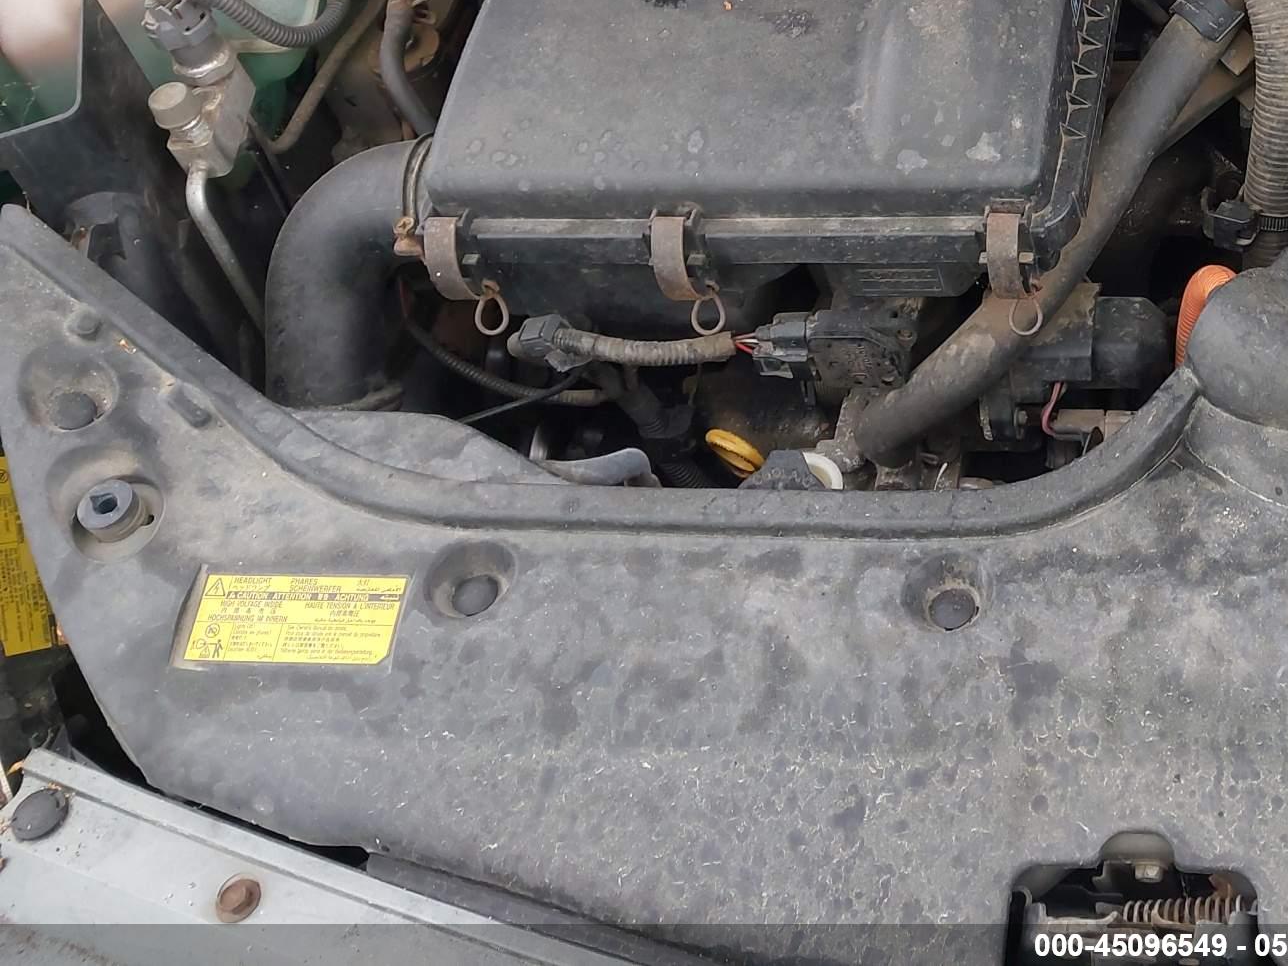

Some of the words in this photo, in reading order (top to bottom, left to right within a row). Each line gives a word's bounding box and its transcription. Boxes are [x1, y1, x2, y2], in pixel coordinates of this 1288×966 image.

[234, 577, 272, 585] HEADLIGHT
[237, 592, 269, 600] CAUTION
[272, 592, 311, 601] ATTENTION
[335, 594, 369, 602] ACHTUNG
[326, 602, 350, 610] TENSION
